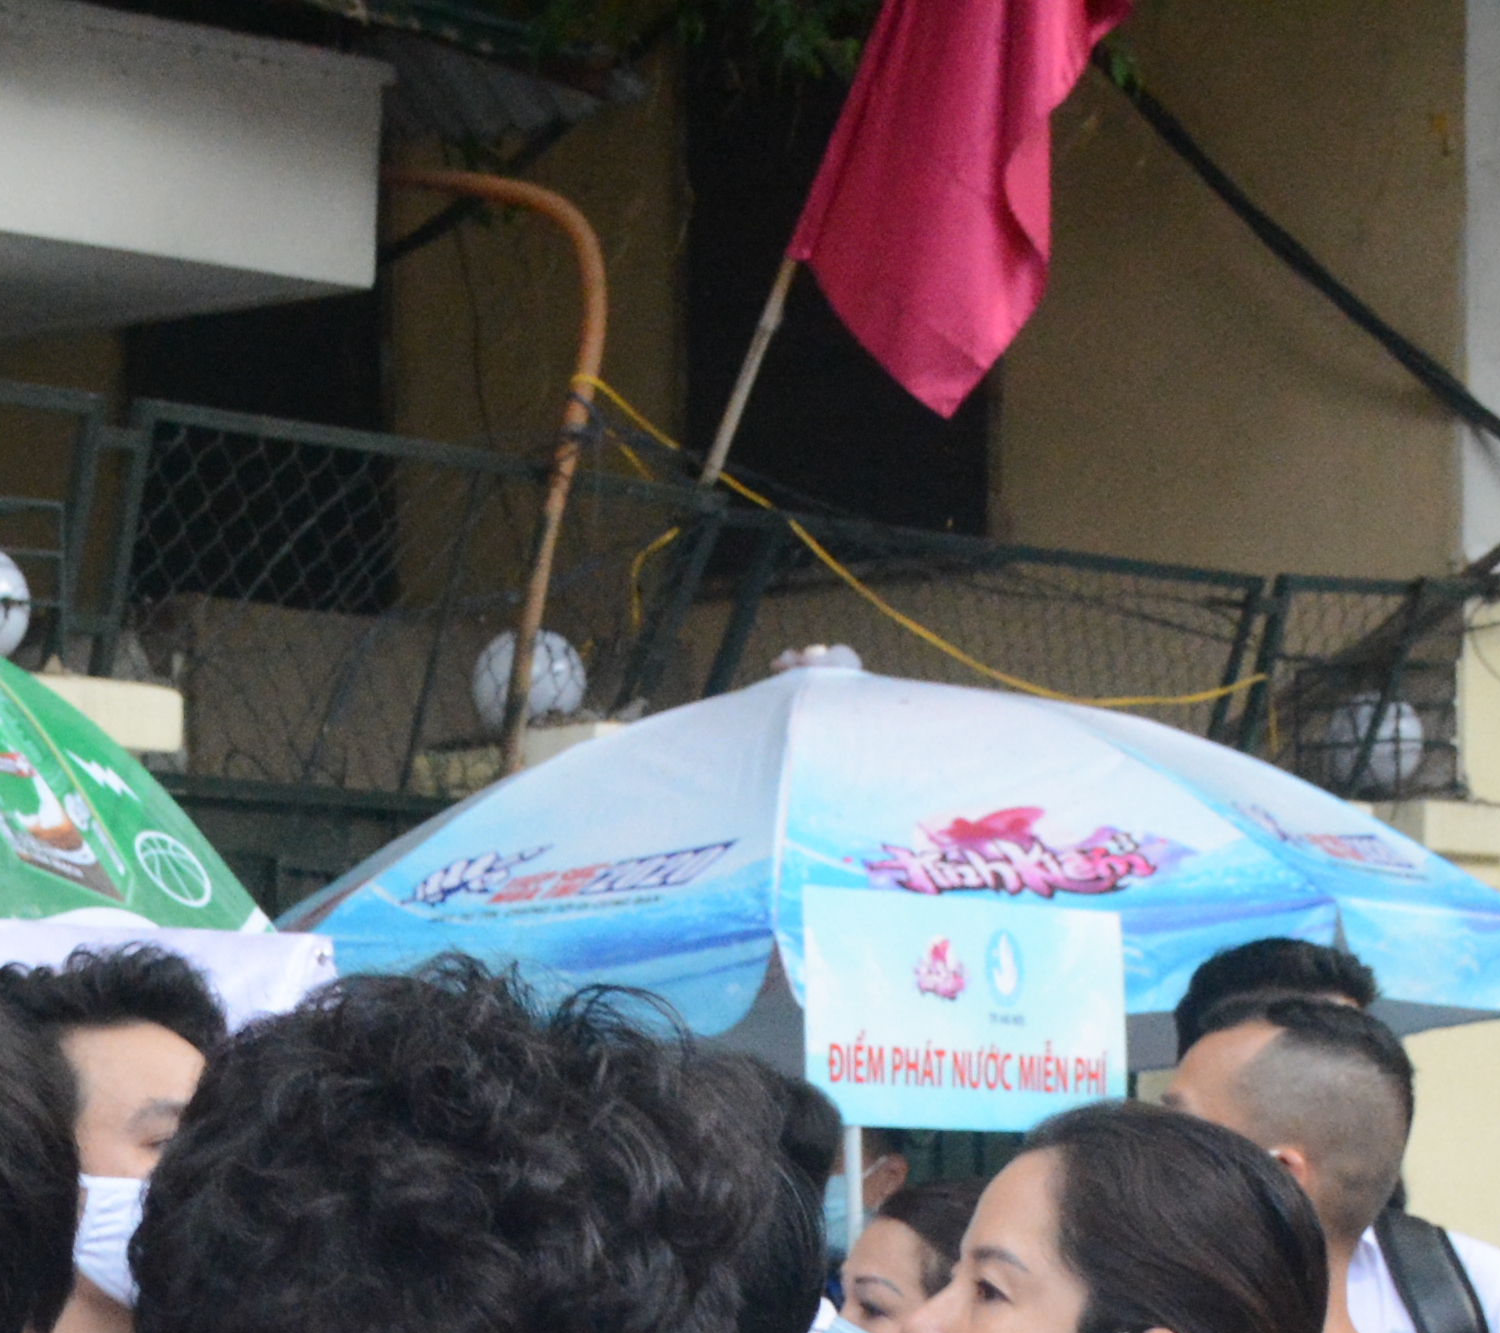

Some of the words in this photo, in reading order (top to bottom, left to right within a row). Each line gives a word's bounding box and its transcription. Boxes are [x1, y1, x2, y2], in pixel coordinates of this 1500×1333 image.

[828, 1029, 885, 1084] ĐIỂM
[892, 1041, 947, 1088] PHÁT
[951, 1045, 1013, 1092] NƯỚC
[1018, 1039, 1070, 1094] MIỄN
[1074, 1050, 1108, 1097] PHÍ
